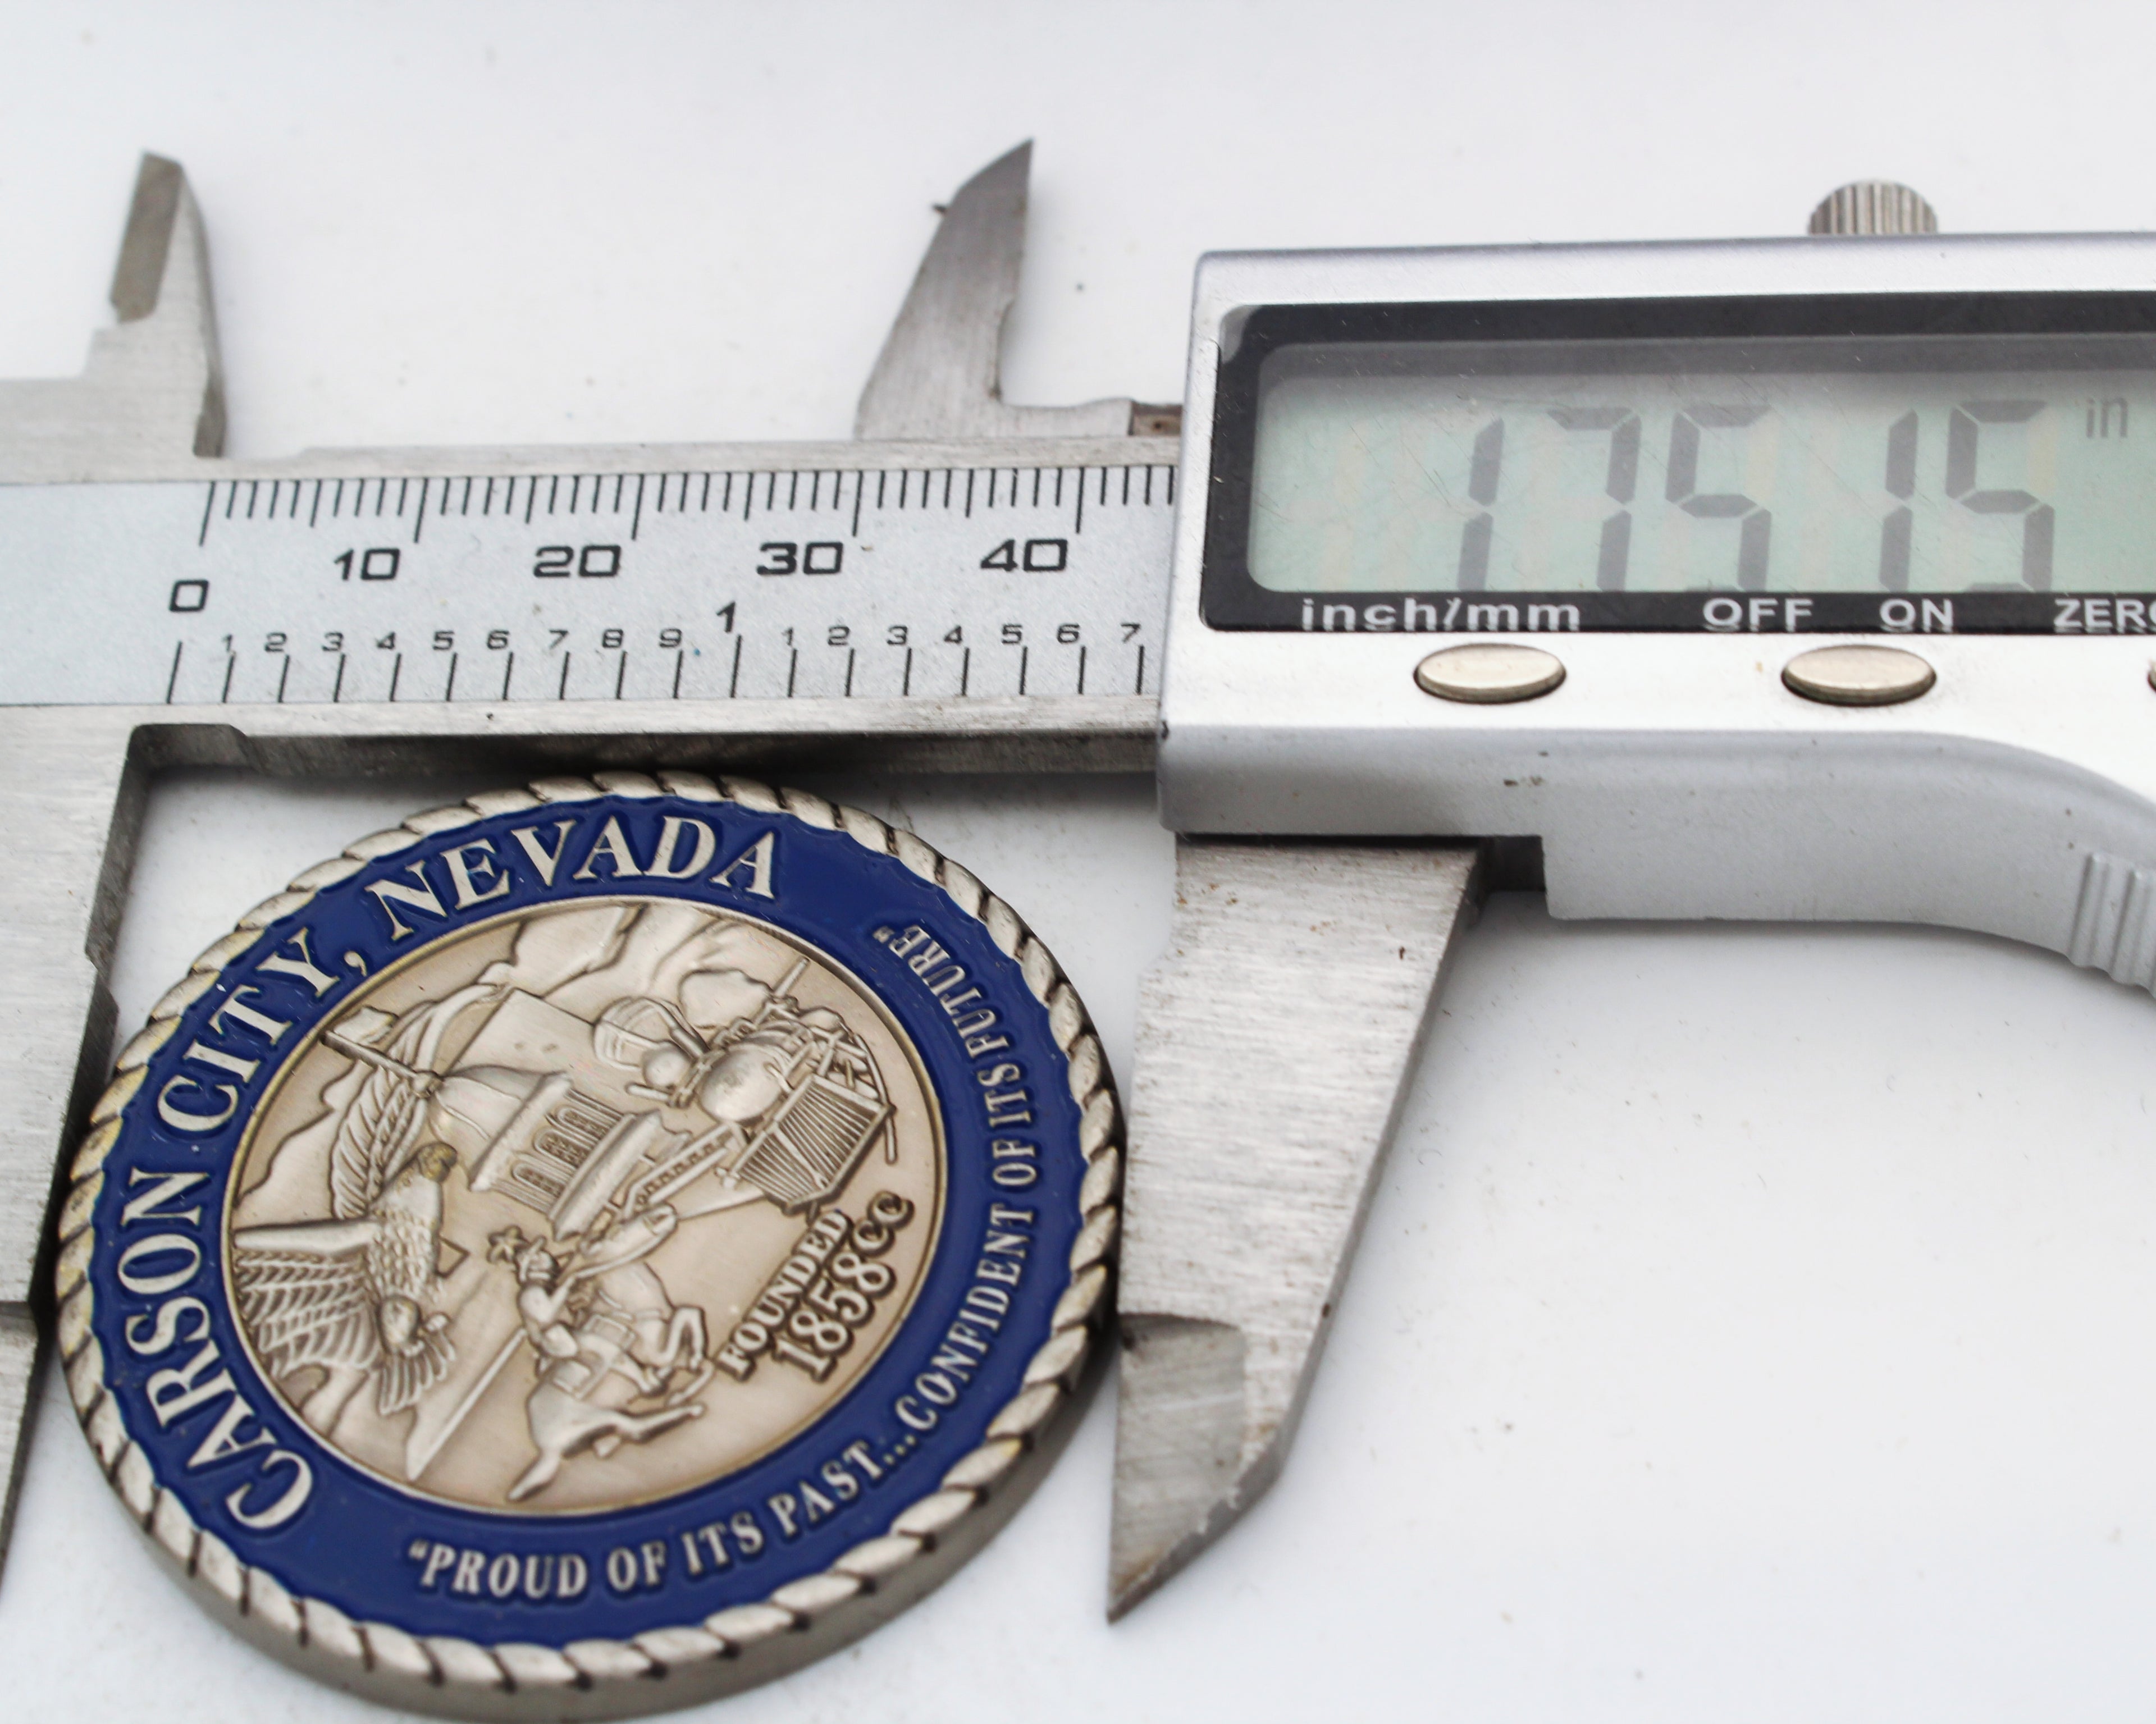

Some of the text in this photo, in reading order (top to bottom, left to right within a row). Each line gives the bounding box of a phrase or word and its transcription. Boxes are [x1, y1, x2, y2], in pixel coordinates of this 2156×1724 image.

[2085, 396, 2129, 439] in
[168, 538, 1068, 613] 0 10 20 30 40
[221, 601, 1141, 652] 1 2 3 4 5 6 7 8 9 1 1 2 3 4 5 6 7
[1302, 597, 2156, 631] inch/mm OFF ON ZER
[977, 1062, 1032, 1128] ITS
[117, 815, 777, 1529] CARSON CITY, NEVADA
[992, 1138, 1037, 1186] OF
[718, 1209, 849, 1377] FOUNDED
[607, 1540, 666, 1592] OF
[681, 1511, 764, 1574] ITS
